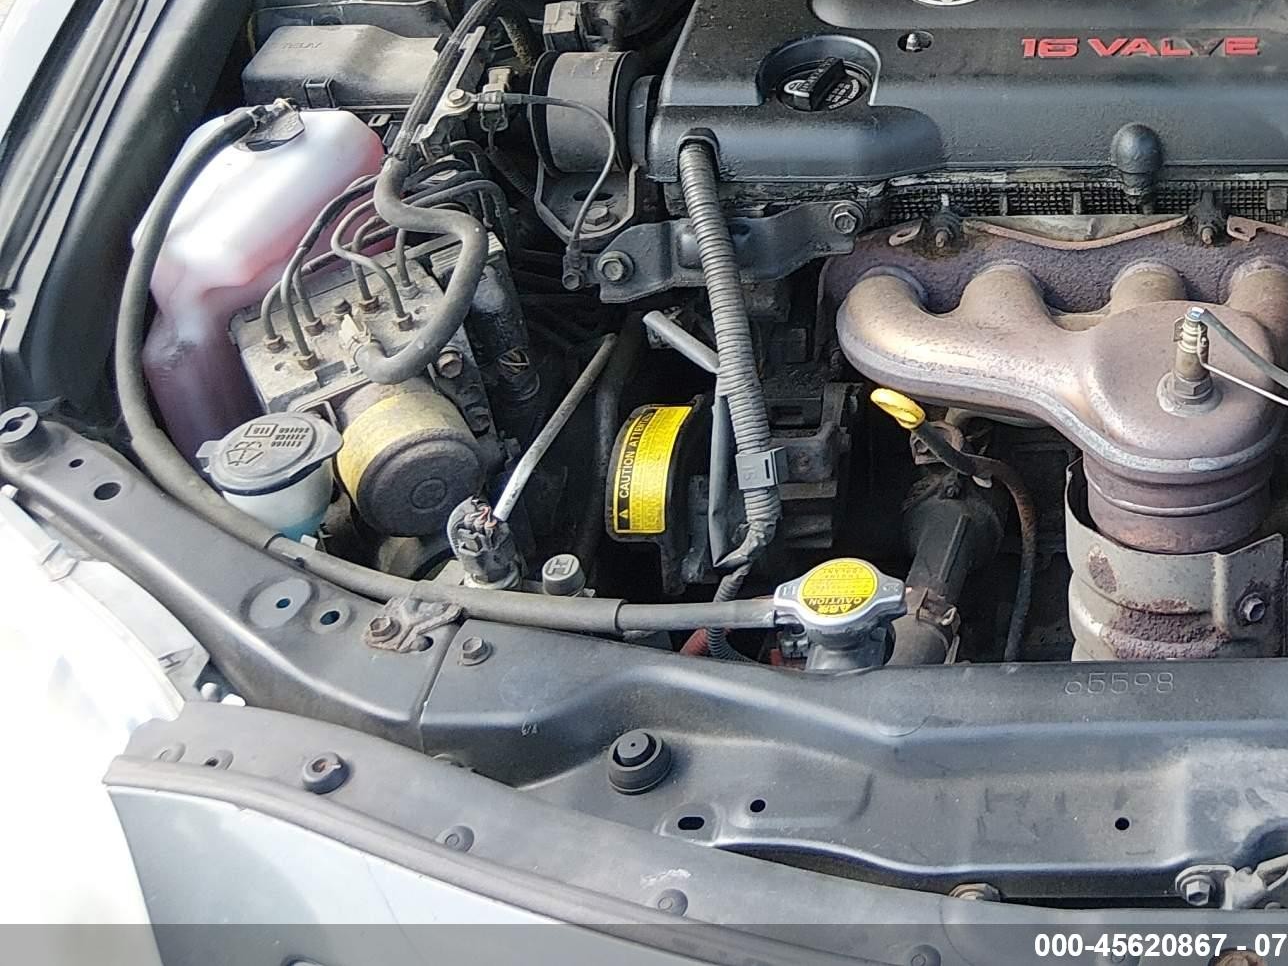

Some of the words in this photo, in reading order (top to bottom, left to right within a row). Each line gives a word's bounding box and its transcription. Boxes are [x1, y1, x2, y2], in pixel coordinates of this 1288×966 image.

[1021, 37, 1079, 59] 16
[1087, 37, 1261, 58] VALVE
[619, 452, 636, 499] CAUTION
[808, 596, 863, 606] CAUTION
